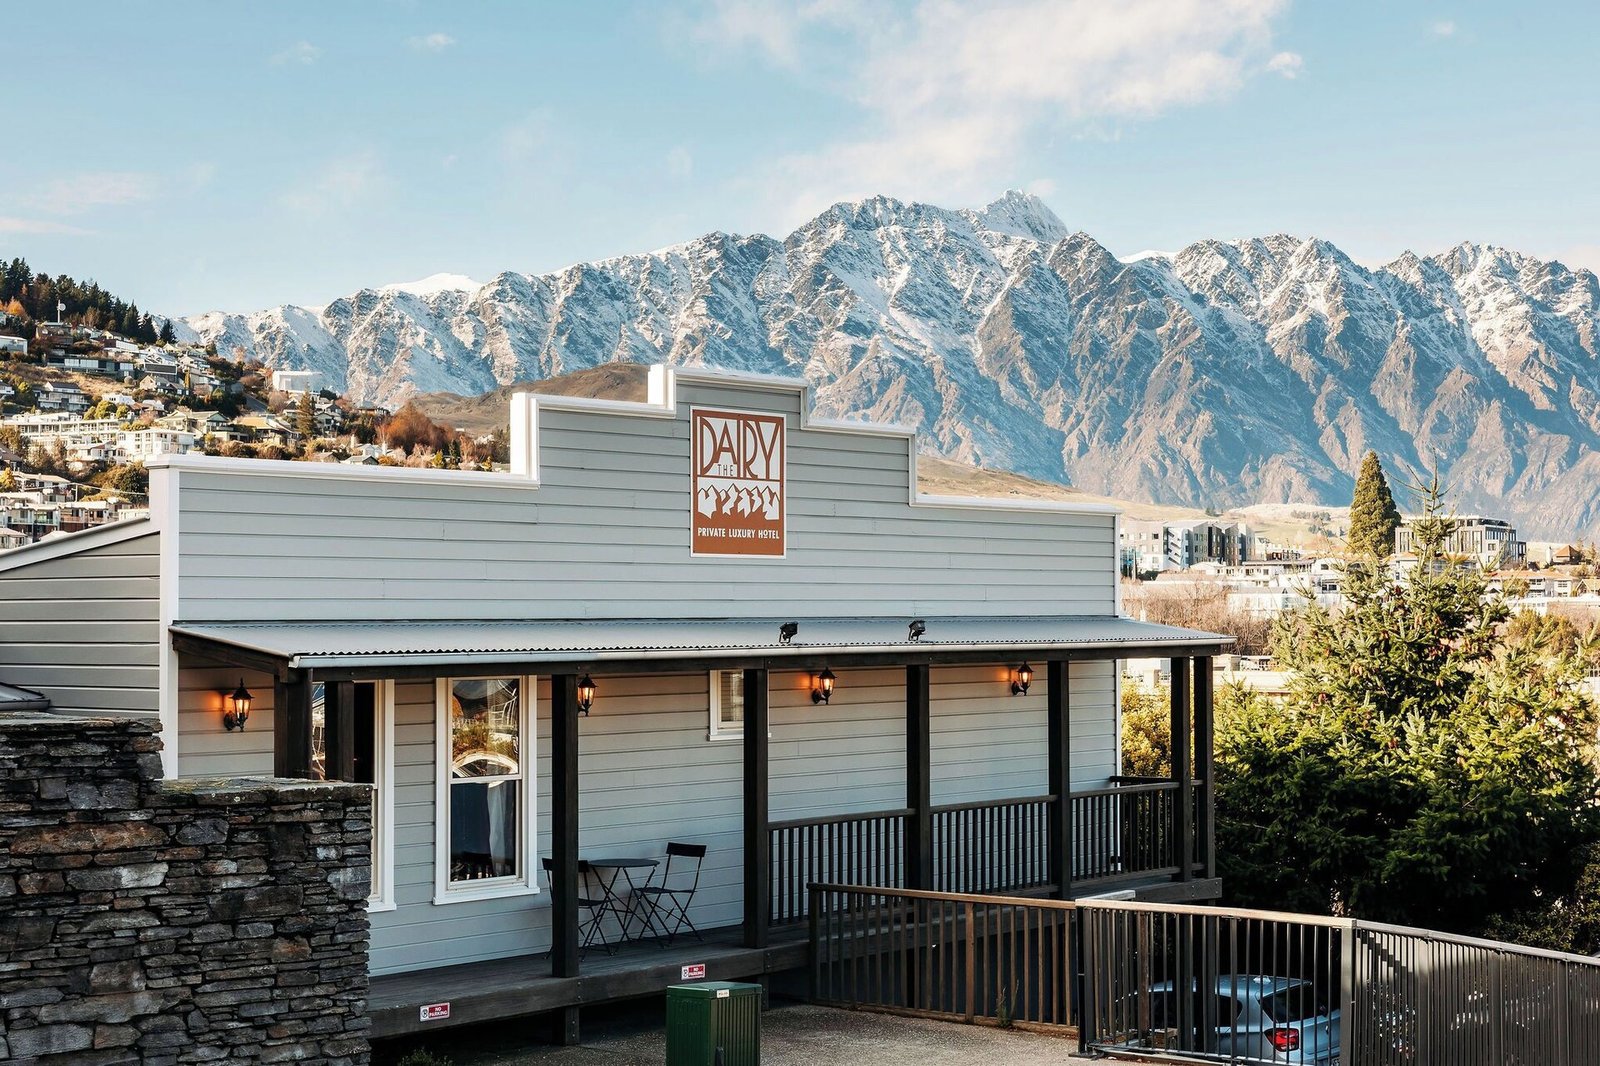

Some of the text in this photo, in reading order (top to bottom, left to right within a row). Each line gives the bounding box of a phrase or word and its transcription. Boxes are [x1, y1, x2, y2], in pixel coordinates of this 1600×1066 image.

[717, 463, 734, 477] THE
[697, 527, 780, 540] PRIVATE LUXURY HOTEL
